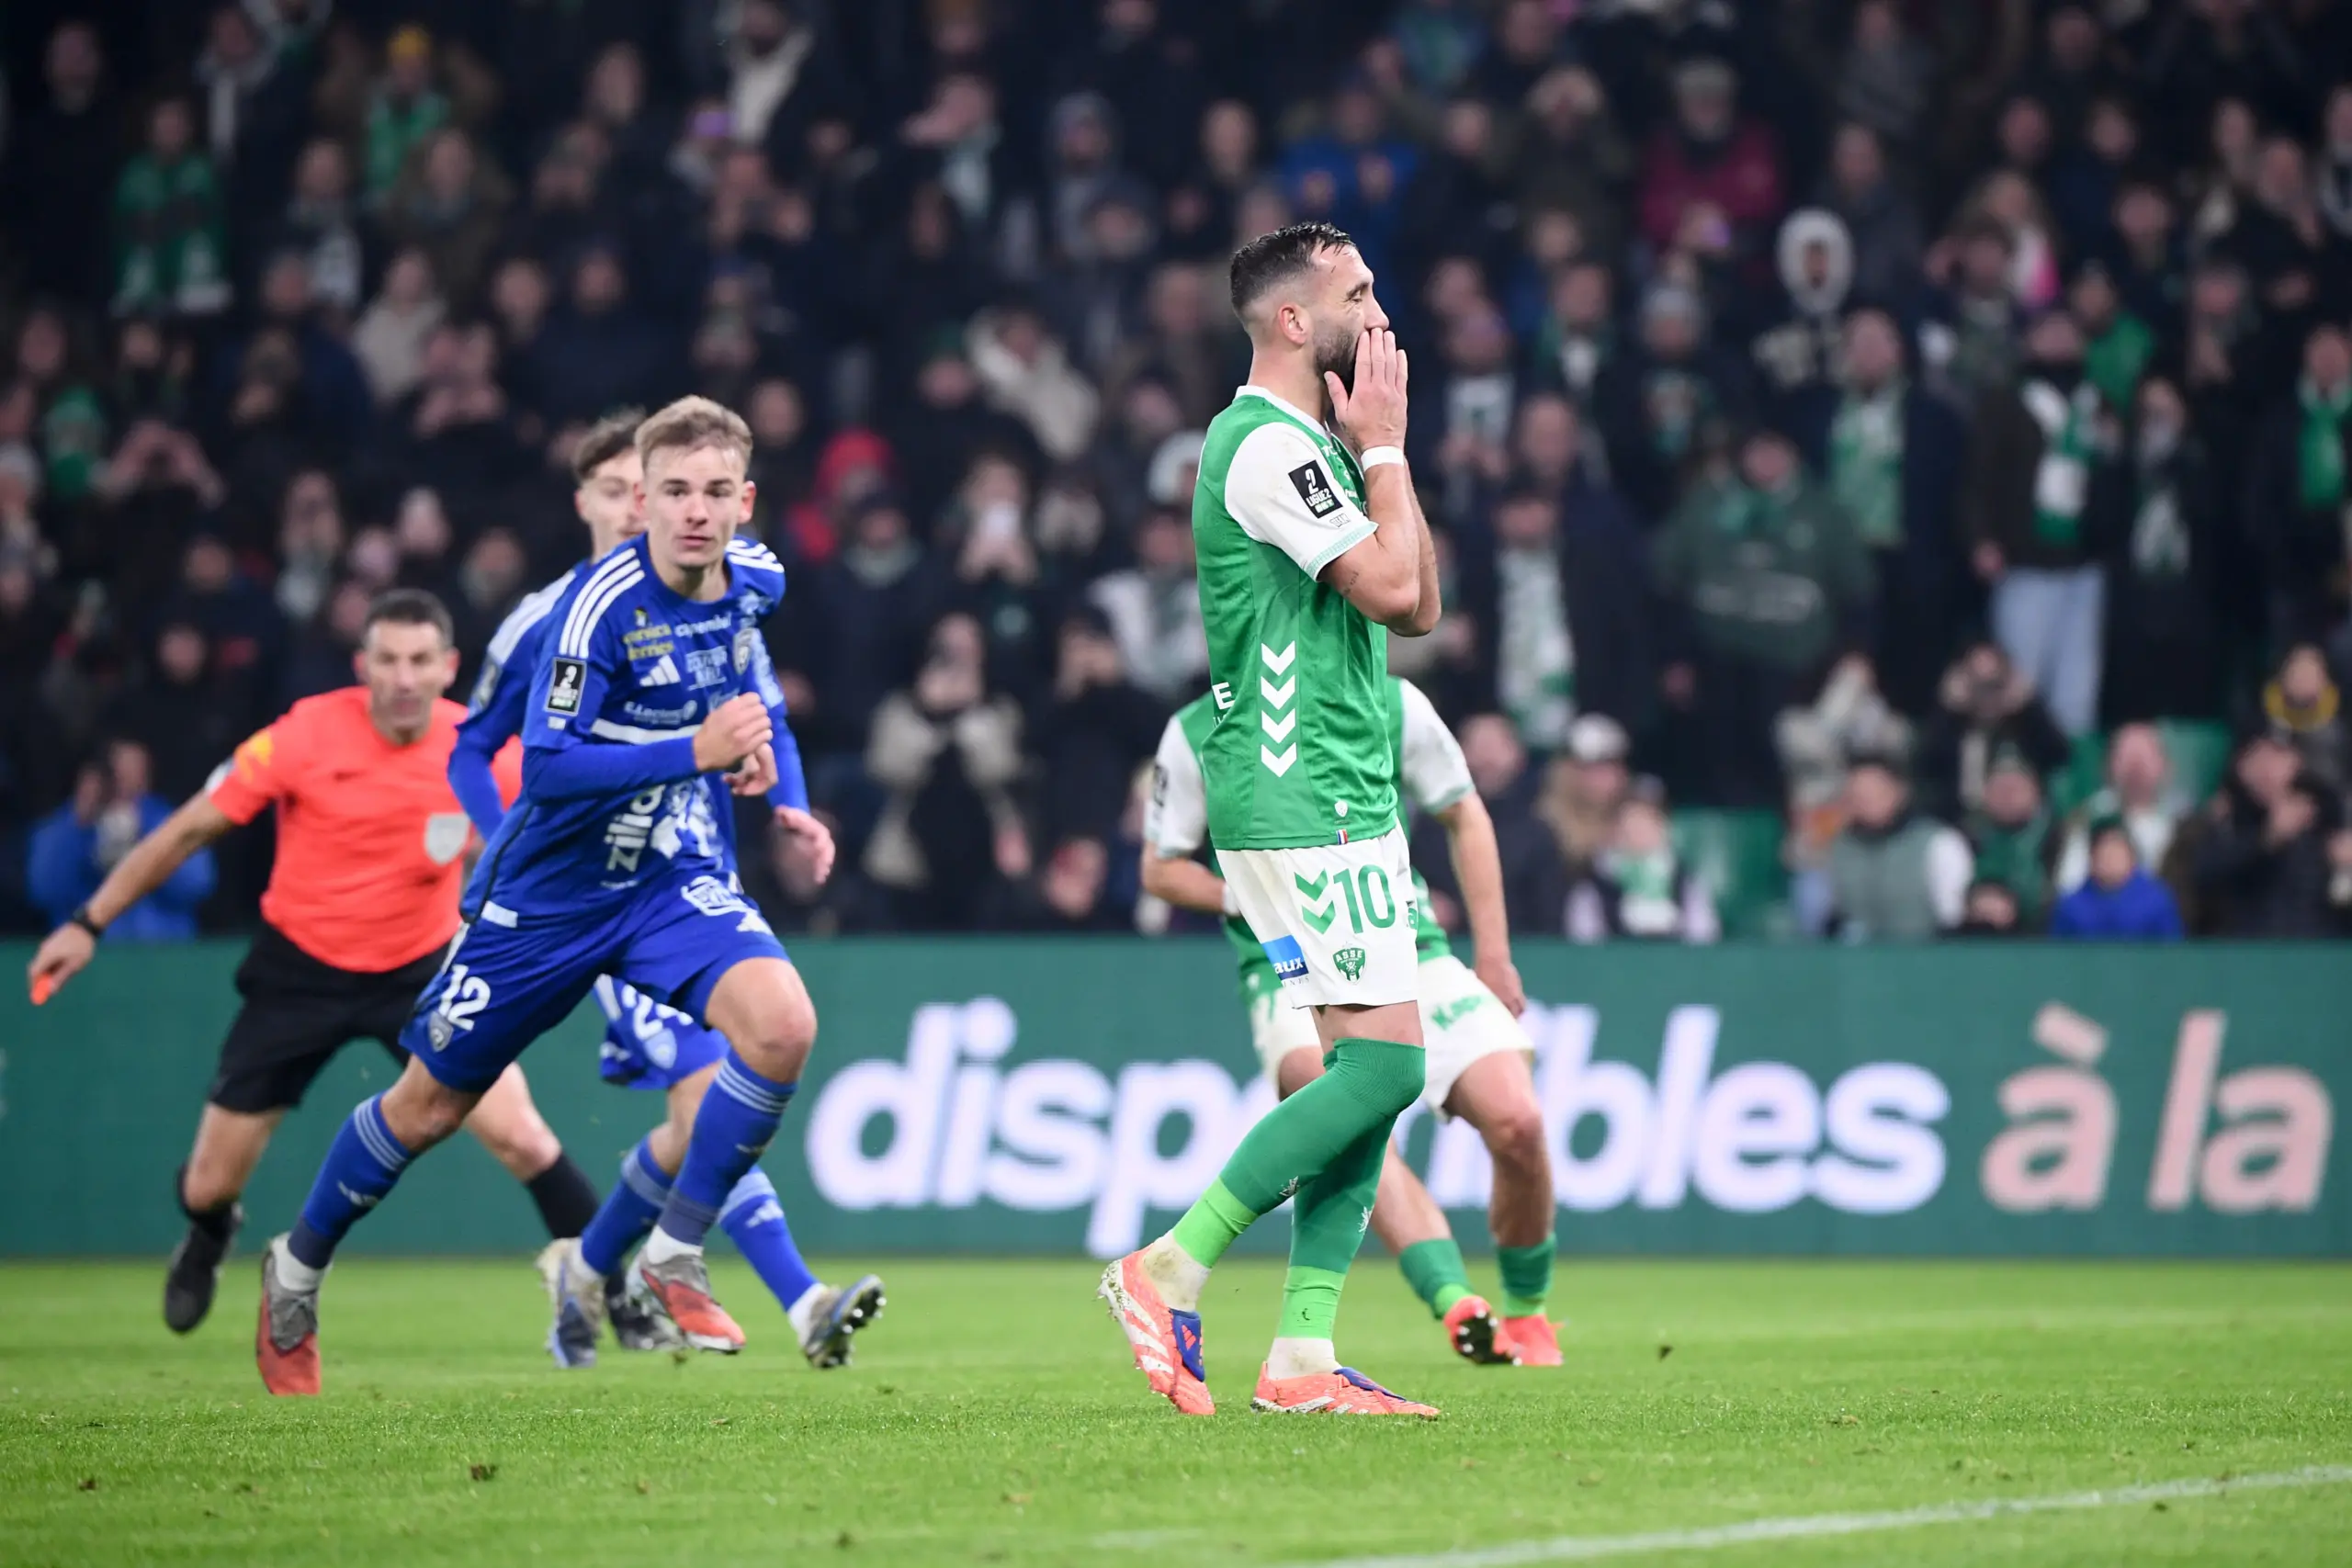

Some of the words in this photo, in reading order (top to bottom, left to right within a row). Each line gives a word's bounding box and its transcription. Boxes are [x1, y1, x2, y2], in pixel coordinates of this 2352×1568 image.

[1305, 468, 1319, 495] 2
[1333, 863, 1396, 934] 10
[1335, 949, 1363, 963] ASSE
[438, 964, 491, 1032] 12
[805, 997, 1951, 1258] dispbles
[1979, 1001, 2119, 1214] à
[2147, 1009, 2334, 1214] la
